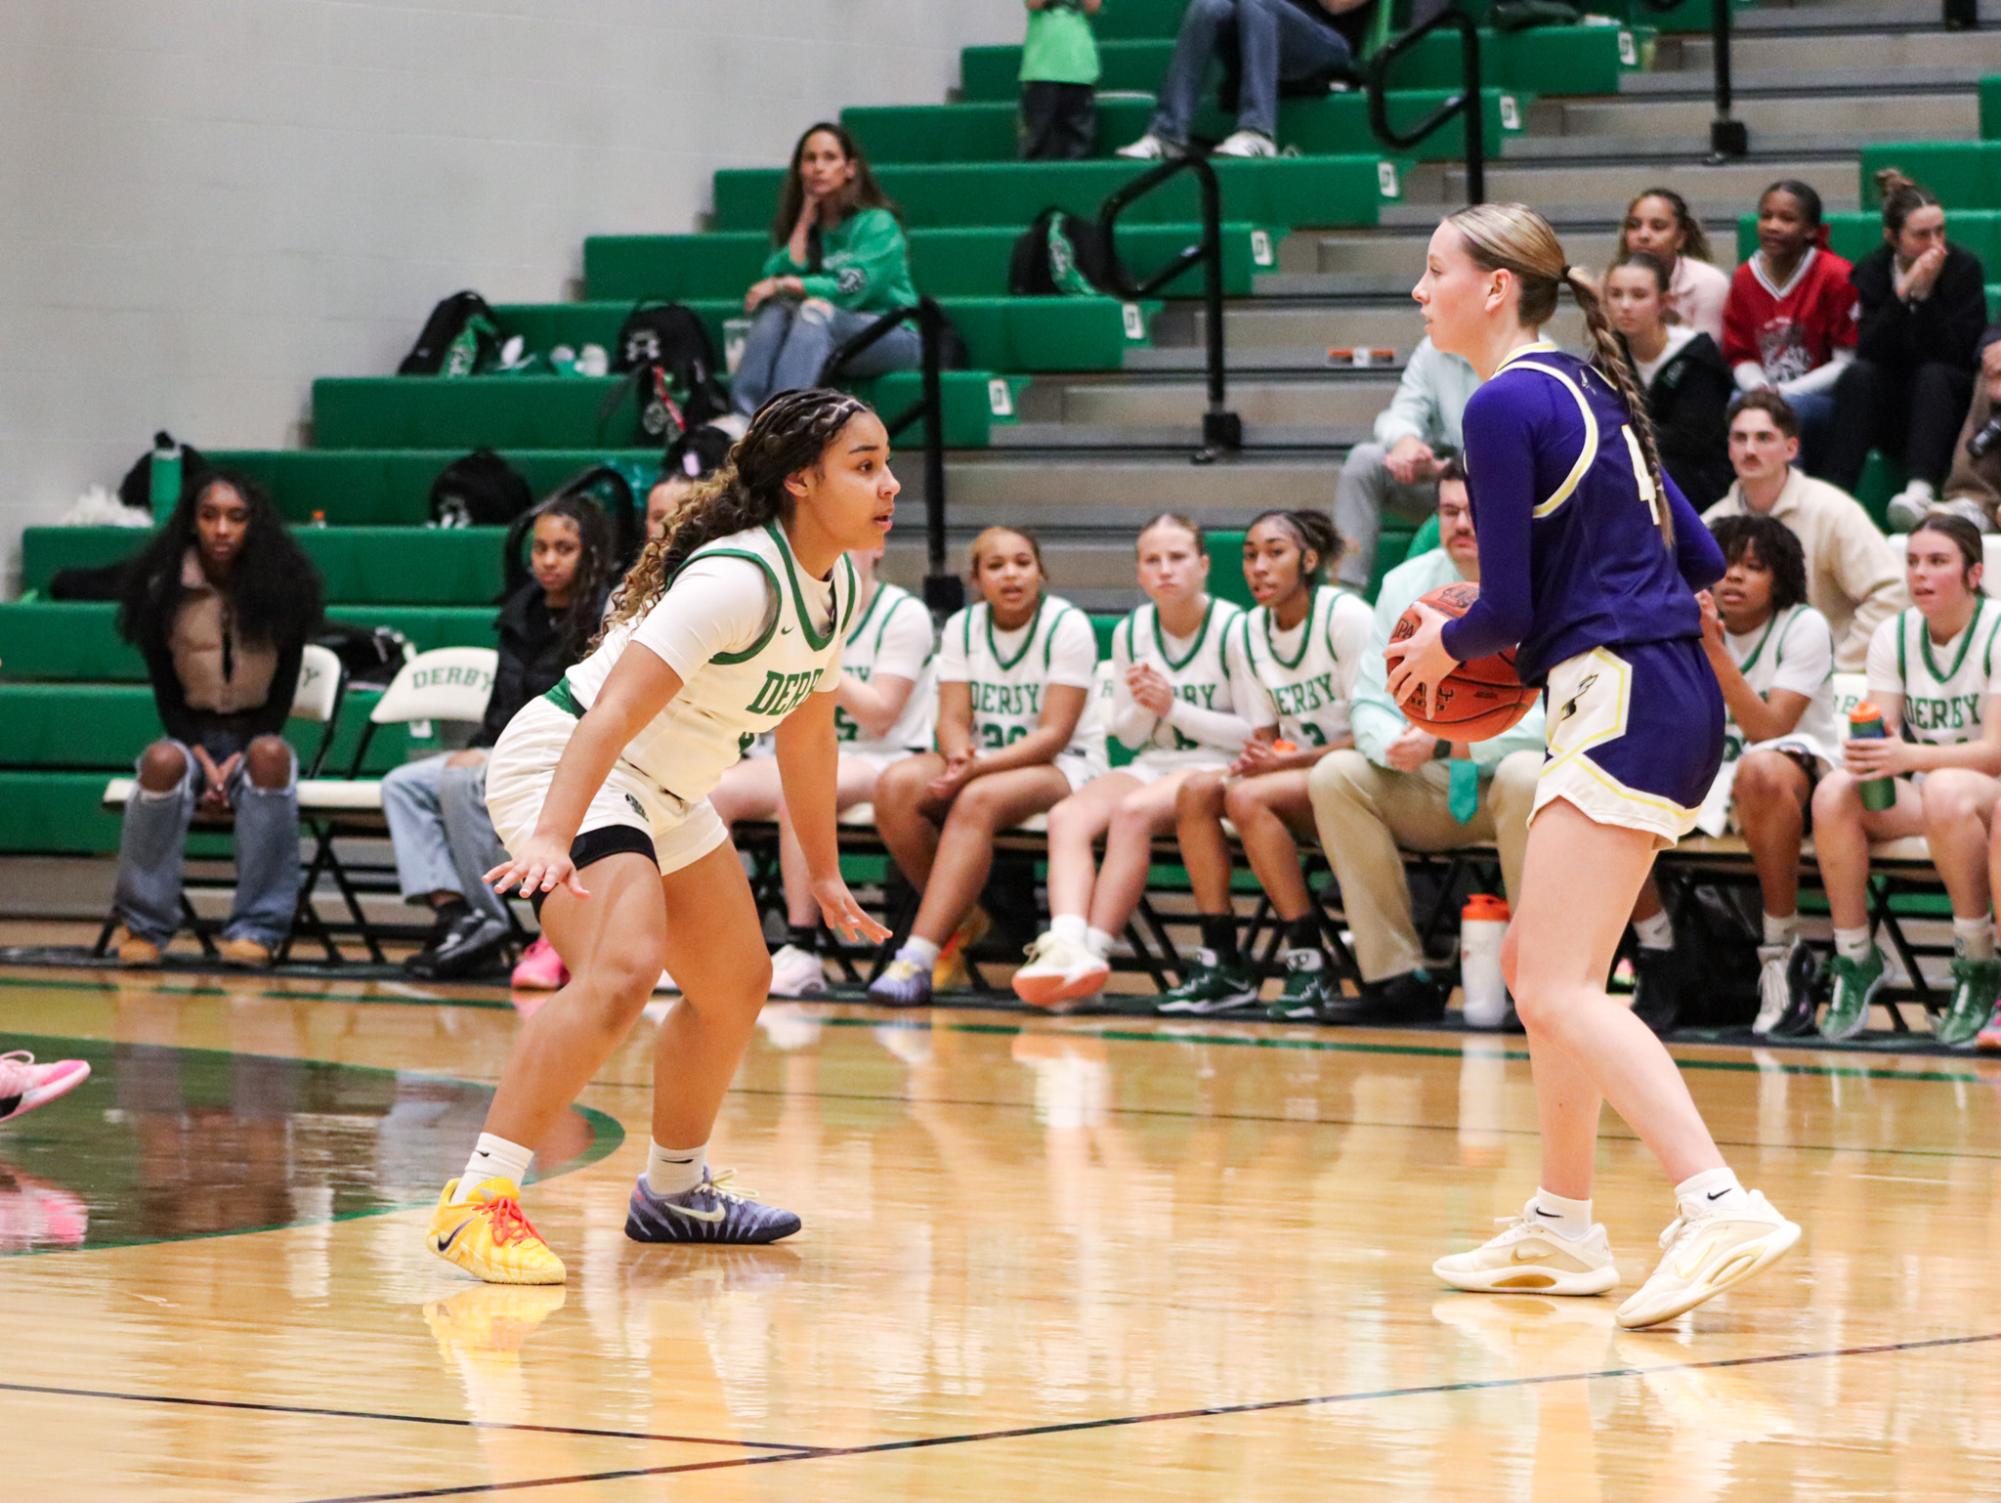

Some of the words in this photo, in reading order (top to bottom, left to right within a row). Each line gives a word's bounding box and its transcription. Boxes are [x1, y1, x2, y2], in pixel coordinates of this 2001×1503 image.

[412, 666, 494, 692] DERBY
[969, 680, 1039, 715] DERBY
[1904, 693, 1981, 729] DERBY
